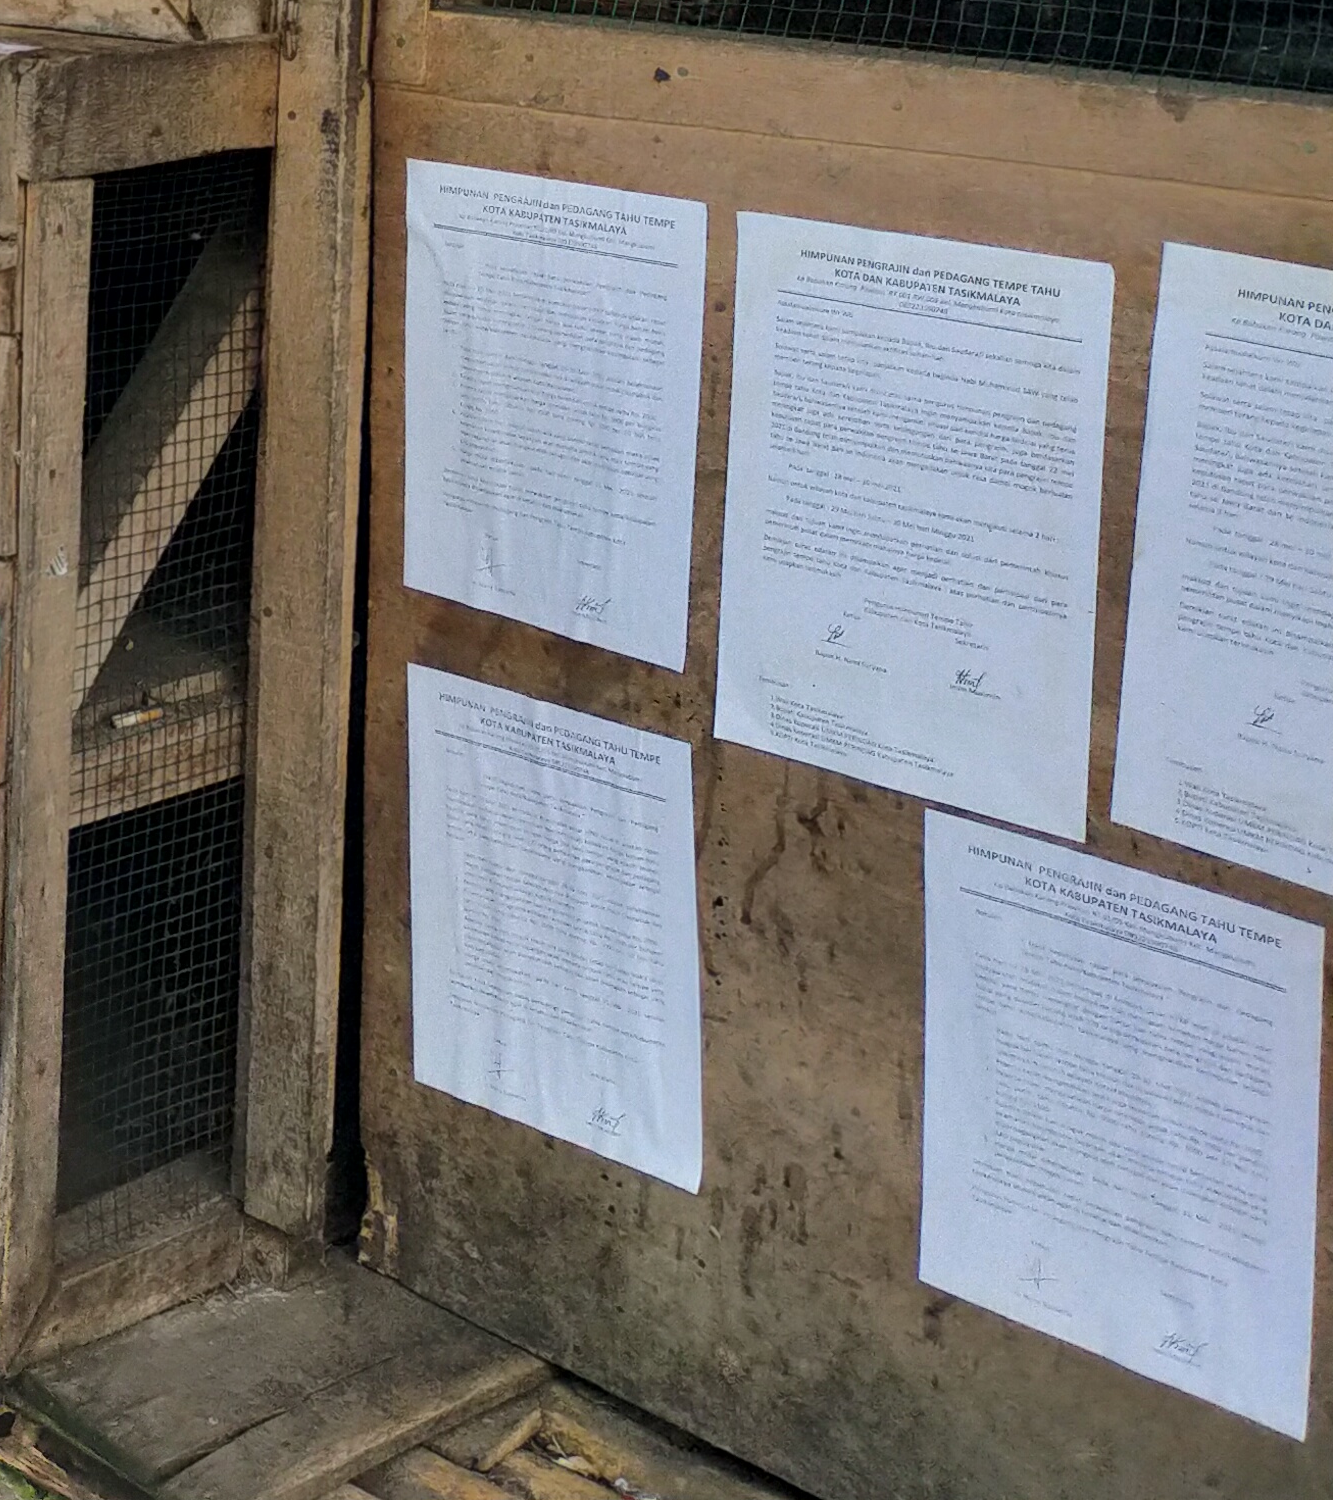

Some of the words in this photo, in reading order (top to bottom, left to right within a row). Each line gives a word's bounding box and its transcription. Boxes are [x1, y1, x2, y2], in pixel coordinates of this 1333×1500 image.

[482, 203, 505, 216] KOTA
[509, 209, 560, 224] KABUPATEN
[565, 218, 625, 235] TASIKMALAYA
[563, 203, 611, 219] PEDAGANG
[615, 212, 639, 224] TAHU
[643, 216, 674, 229] TEMPE
[800, 250, 853, 264] HIMPUNAN
[857, 258, 909, 273] PENGRAJIN
[912, 266, 930, 277] dan
[934, 270, 989, 286] PEDAGANG
[993, 279, 1027, 292] TEMPE
[1031, 285, 1060, 297] TAHU
[834, 268, 860, 281] KOTA
[862, 272, 883, 284] DAN
[886, 277, 944, 293] KABUPATEN
[948, 287, 1020, 305] TASIKMALAYA
[1238, 289, 1304, 308] HIMPUNAN
[1280, 312, 1310, 325] KOTA
[481, 717, 501, 731] KOTA
[556, 740, 614, 764] TASIKMALAYA
[604, 741, 627, 755] TAHU
[630, 749, 659, 764] TEMPE
[969, 845, 1031, 871] HIMPUNAN
[1039, 866, 1101, 893] PENGRAJIN
[1105, 885, 1126, 901] dan
[1130, 893, 1196, 922] PEDAGANG
[1201, 915, 1234, 934] TAHU
[1239, 927, 1281, 948] TEMPE
[1026, 877, 1055, 894] KOTA
[1060, 887, 1127, 916] KABUPATEN
[1133, 909, 1216, 943] TASIKMALAYA
